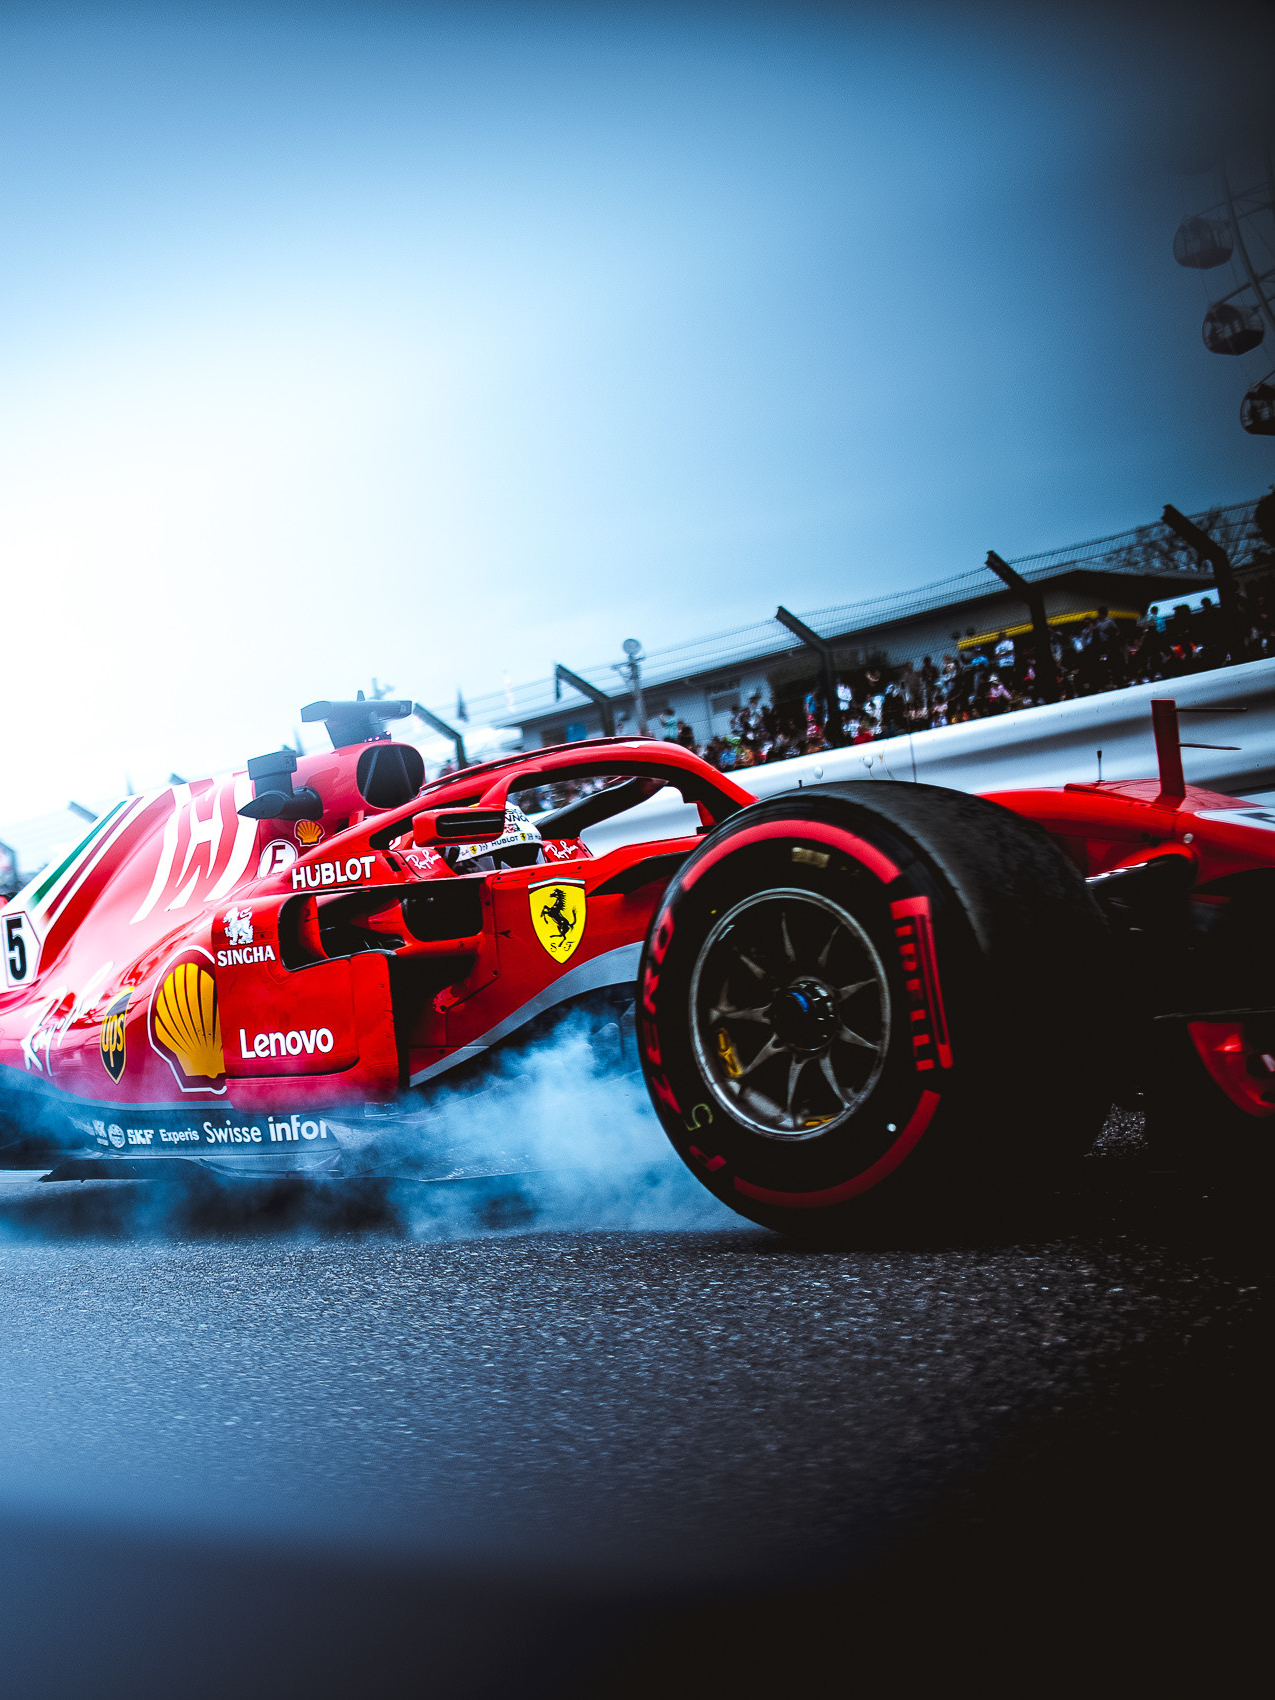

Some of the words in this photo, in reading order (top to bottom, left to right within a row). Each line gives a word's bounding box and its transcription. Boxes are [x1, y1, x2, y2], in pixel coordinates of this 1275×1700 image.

[491, 835, 519, 847] HUBLOT
[291, 855, 376, 890] HUBLOT
[6, 917, 27, 980] 5
[217, 945, 276, 967] SINGHA
[239, 1027, 334, 1059] Lenovo
[126, 1129, 154, 1145] SKF
[159, 1127, 200, 1144] Experis
[203, 1119, 263, 1144] Swisse
[267, 1114, 328, 1142] infor
